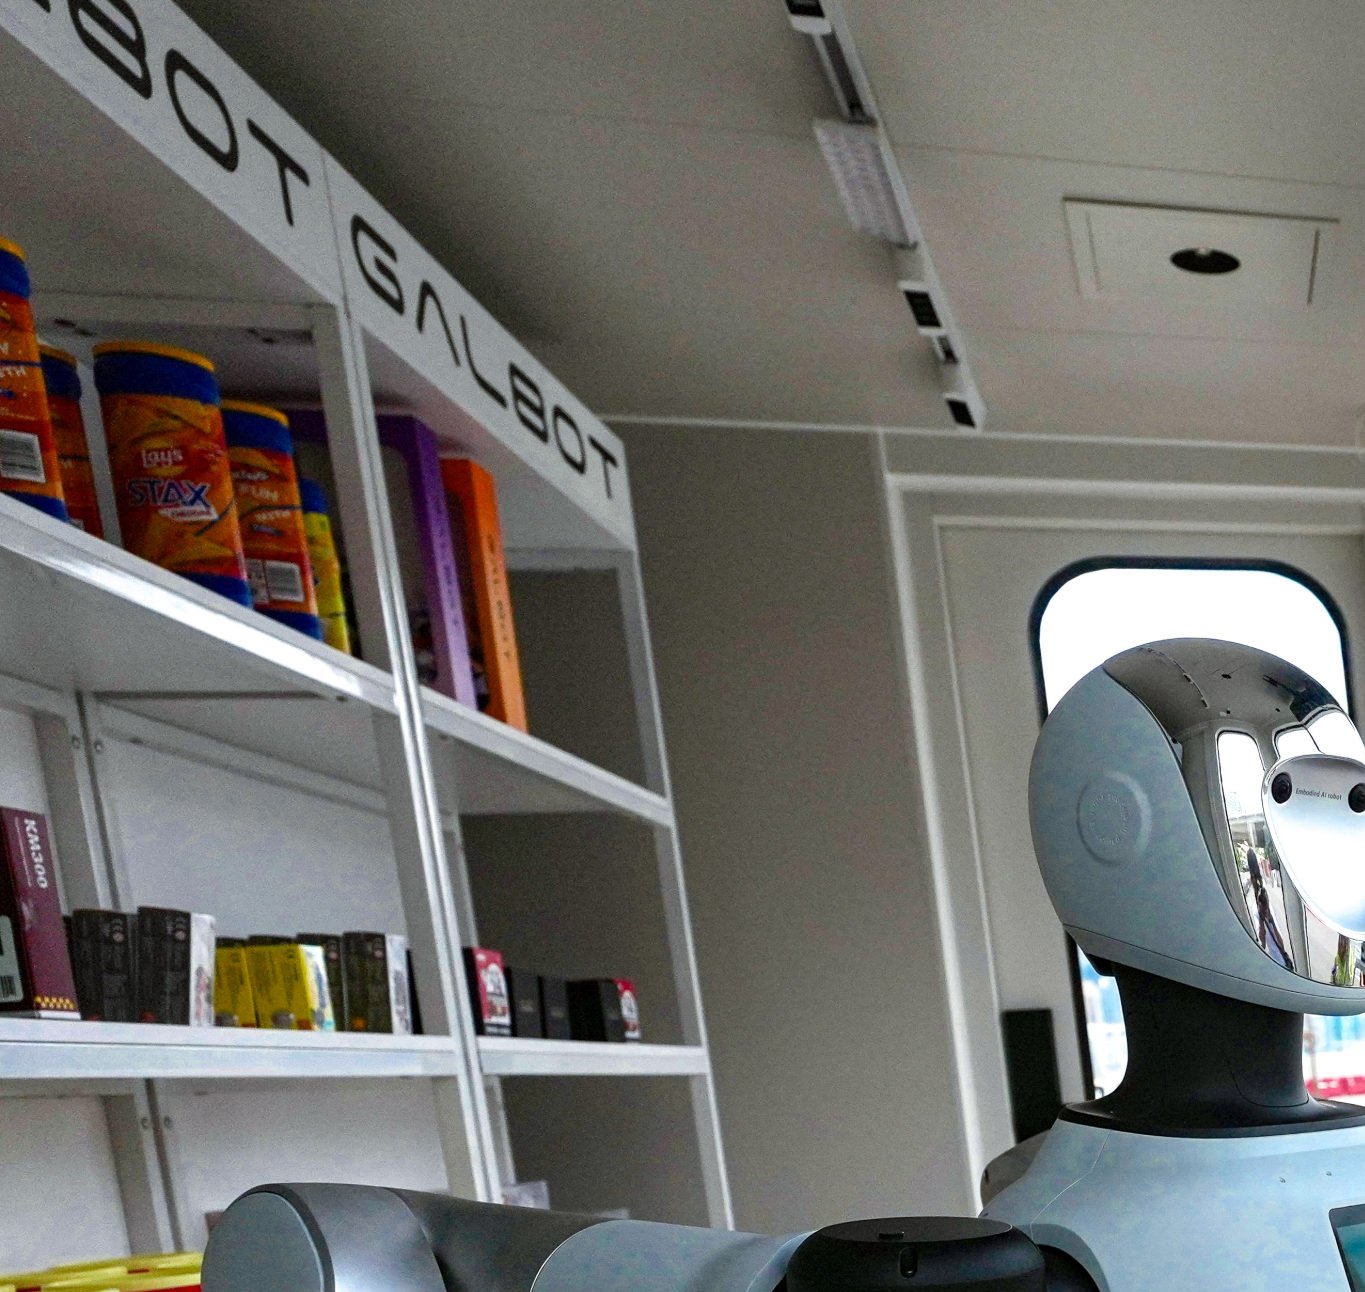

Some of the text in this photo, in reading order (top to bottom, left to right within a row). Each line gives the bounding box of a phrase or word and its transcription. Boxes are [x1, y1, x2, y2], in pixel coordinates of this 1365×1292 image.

[33, 0, 310, 227] BOT
[350, 213, 619, 500] GALBOT
[127, 478, 212, 509] STAX
